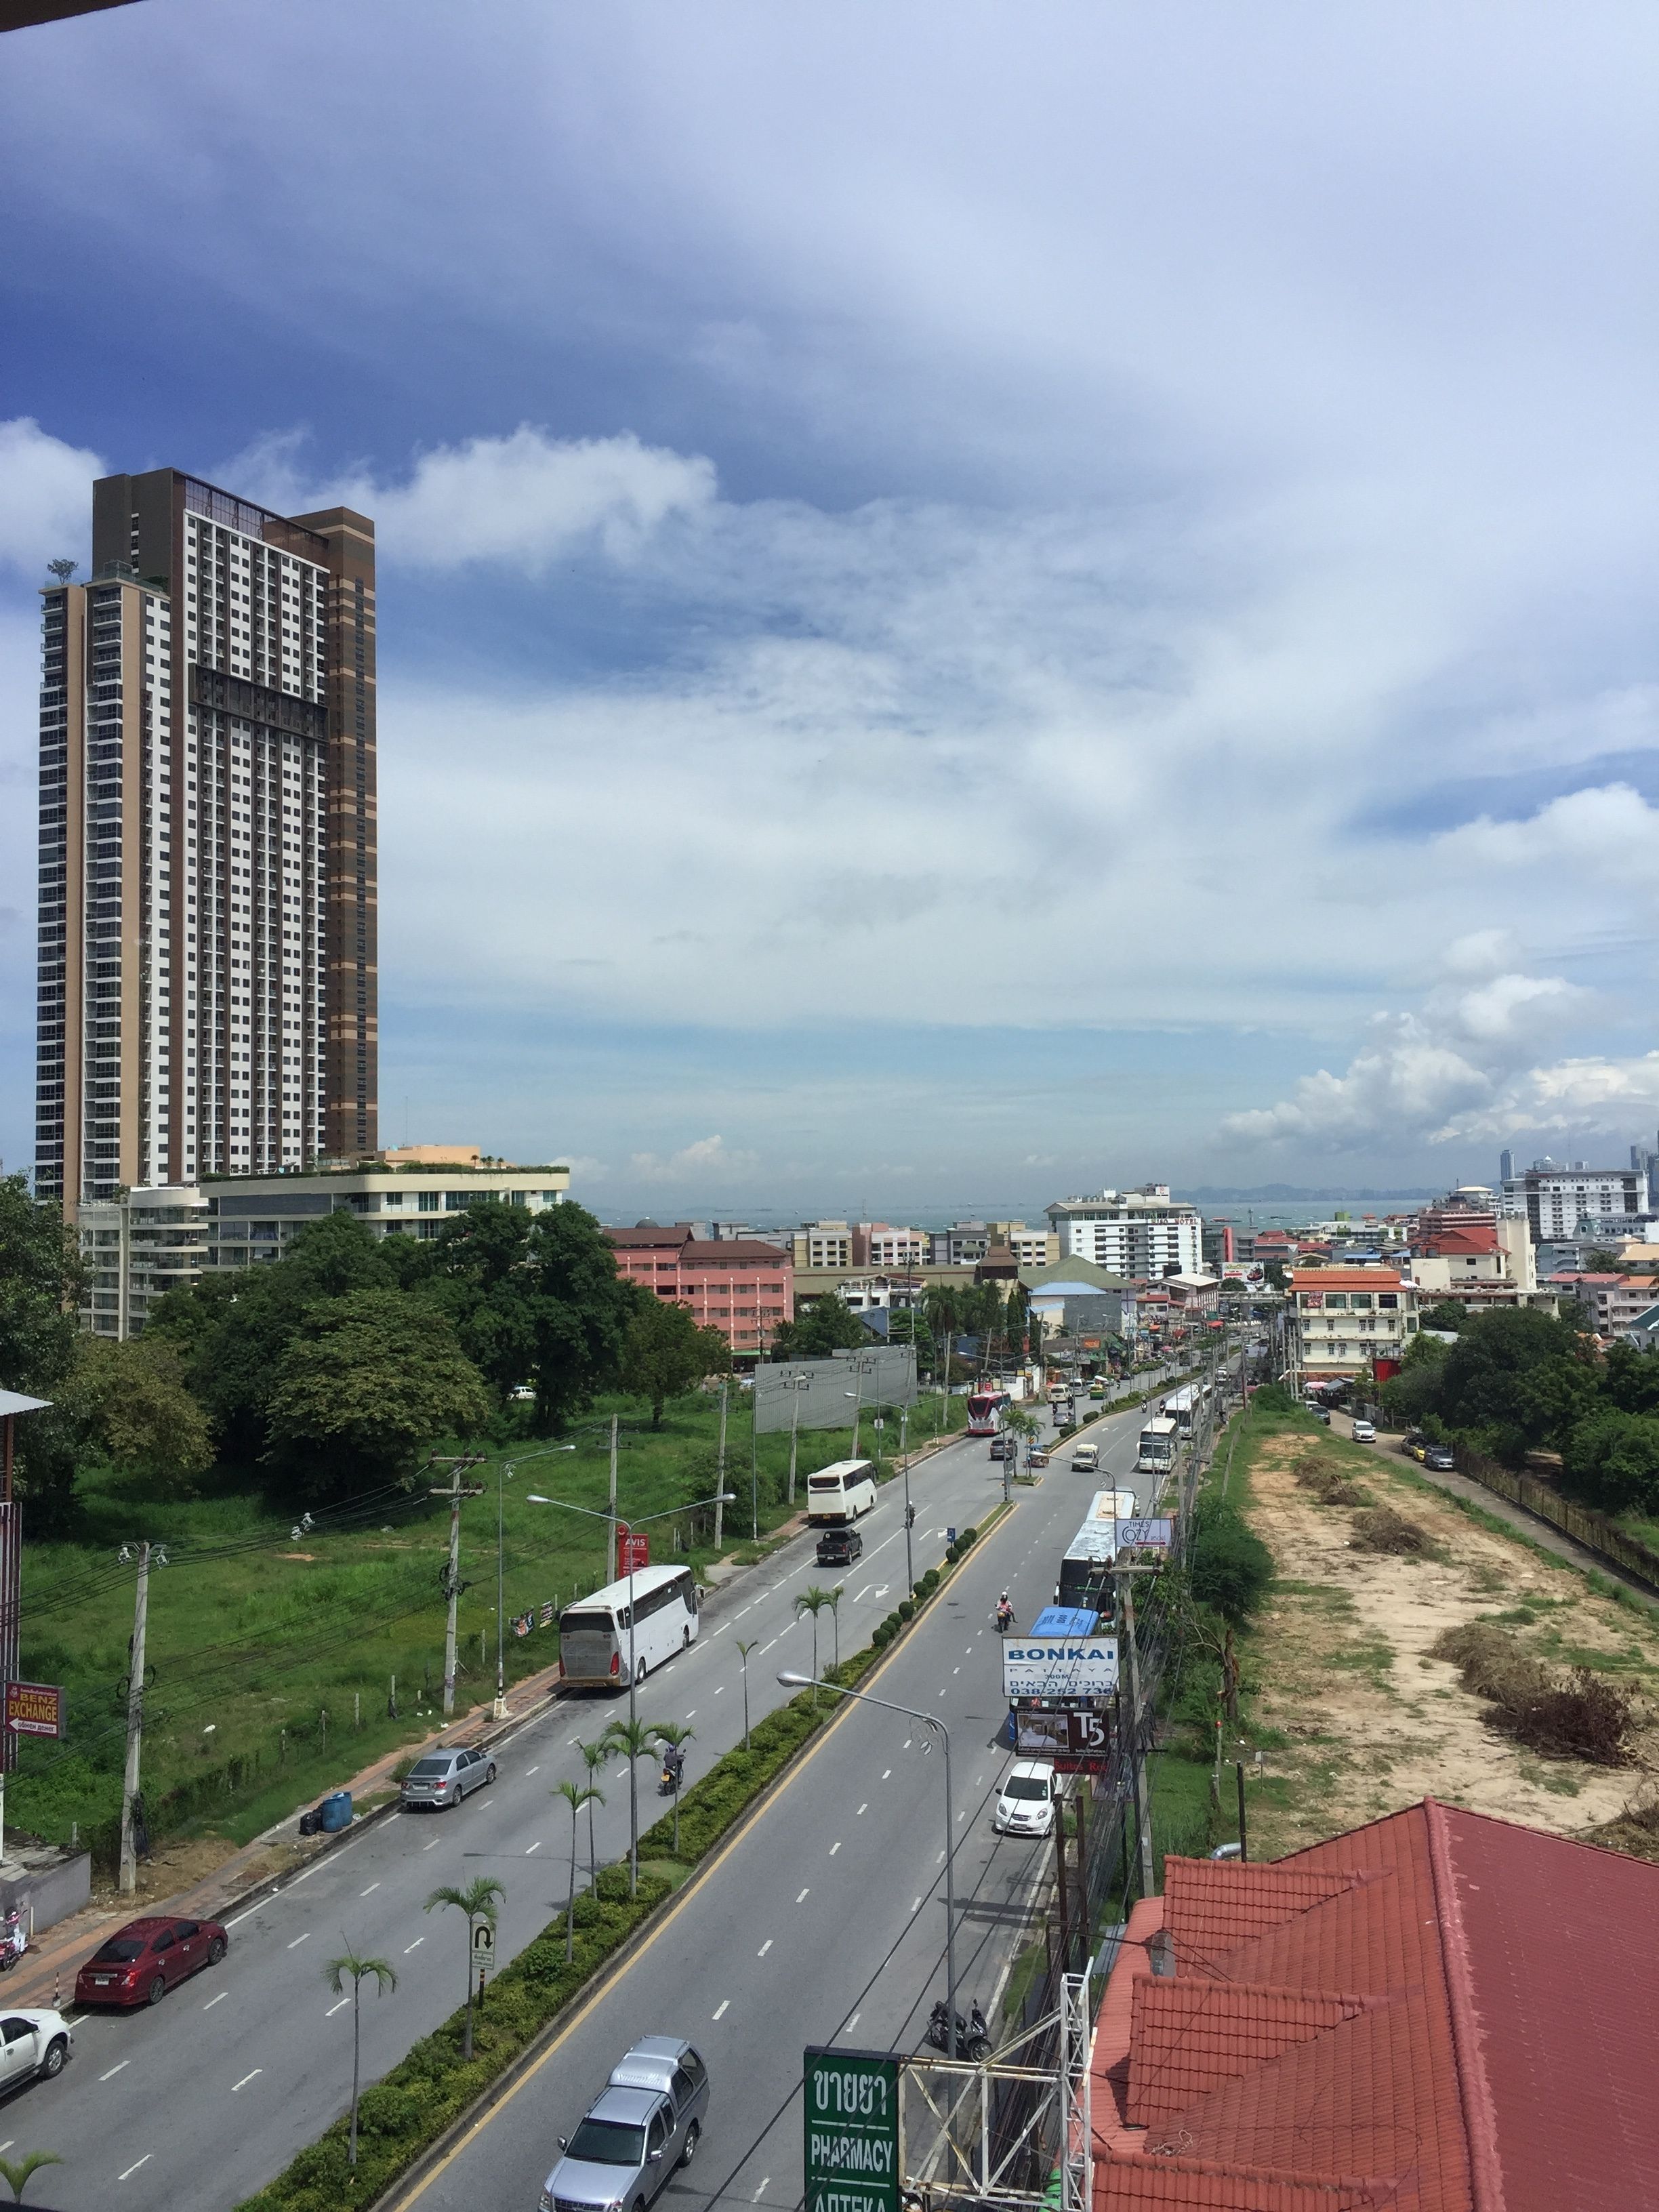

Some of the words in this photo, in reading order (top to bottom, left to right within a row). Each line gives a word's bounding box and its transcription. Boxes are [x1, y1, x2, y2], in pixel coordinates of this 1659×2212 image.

[1008, 1648, 1113, 1660] BONKAI
[20, 1694, 57, 1705] BENZ
[9, 1701, 57, 1721] EXCHANGE
[814, 2070, 886, 2115] ขายยา
[811, 2134, 893, 2173] PHARMACY
